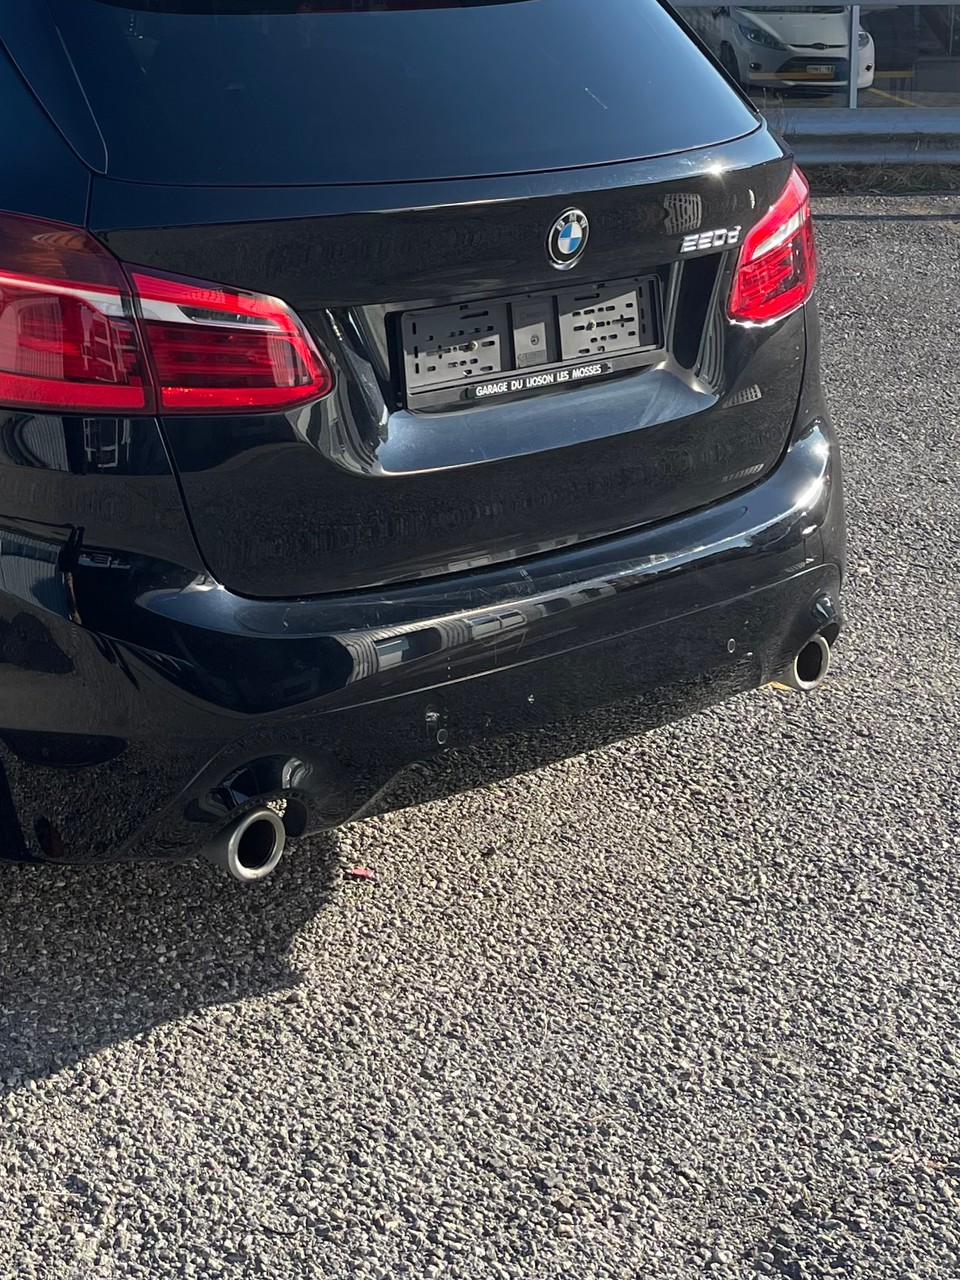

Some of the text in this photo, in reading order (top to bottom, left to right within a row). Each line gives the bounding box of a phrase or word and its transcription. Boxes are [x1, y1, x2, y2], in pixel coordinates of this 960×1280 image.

[556, 213, 587, 231] BMW
[680, 225, 742, 253] 220d
[475, 381, 508, 397] GARAGE
[511, 379, 524, 390] DU
[556, 370, 569, 382] LES
[571, 364, 602, 379] MOSSES
